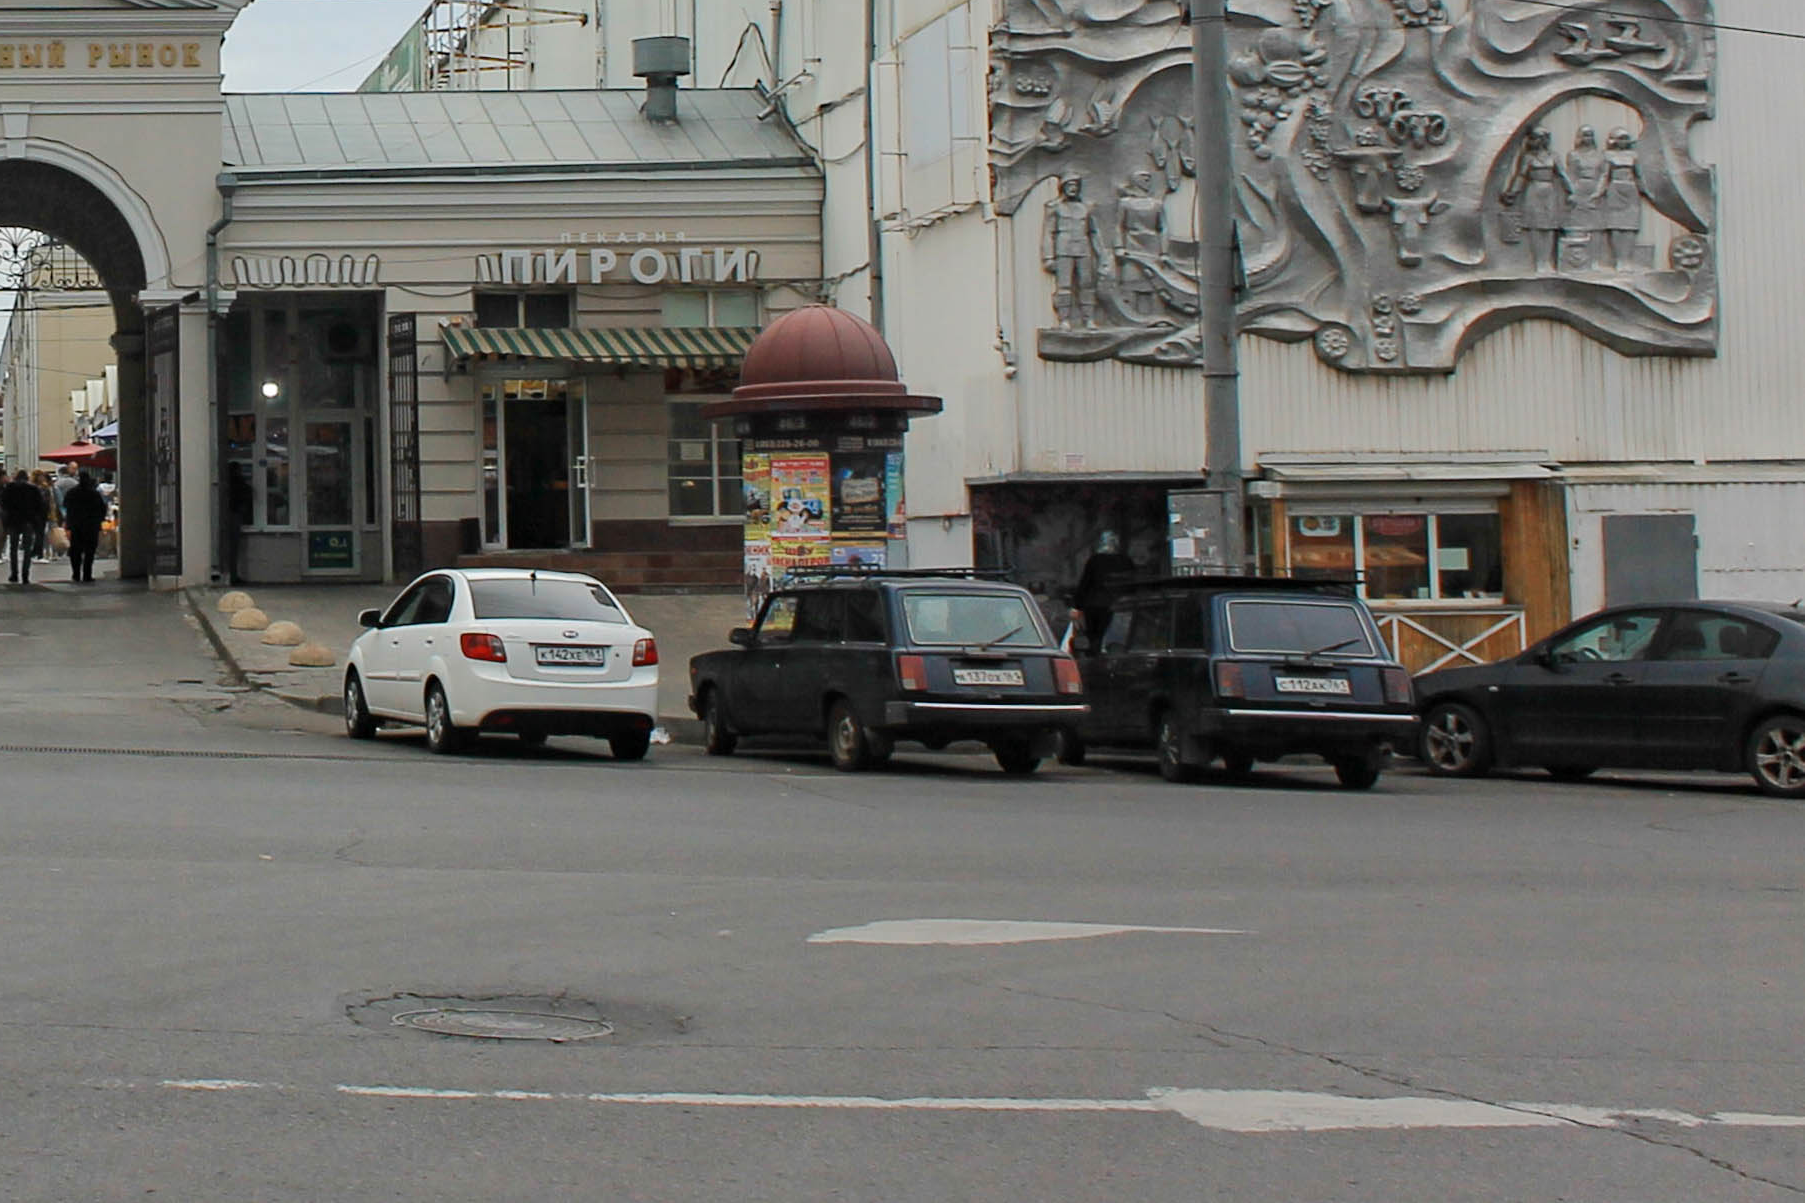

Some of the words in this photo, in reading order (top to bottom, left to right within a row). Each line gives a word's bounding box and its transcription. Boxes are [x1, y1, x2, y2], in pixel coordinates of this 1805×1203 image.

[87, 43, 201, 69] РЫНОК
[560, 231, 686, 244] ПЕКАРНЯ
[501, 247, 747, 285] ПИРОГИ
